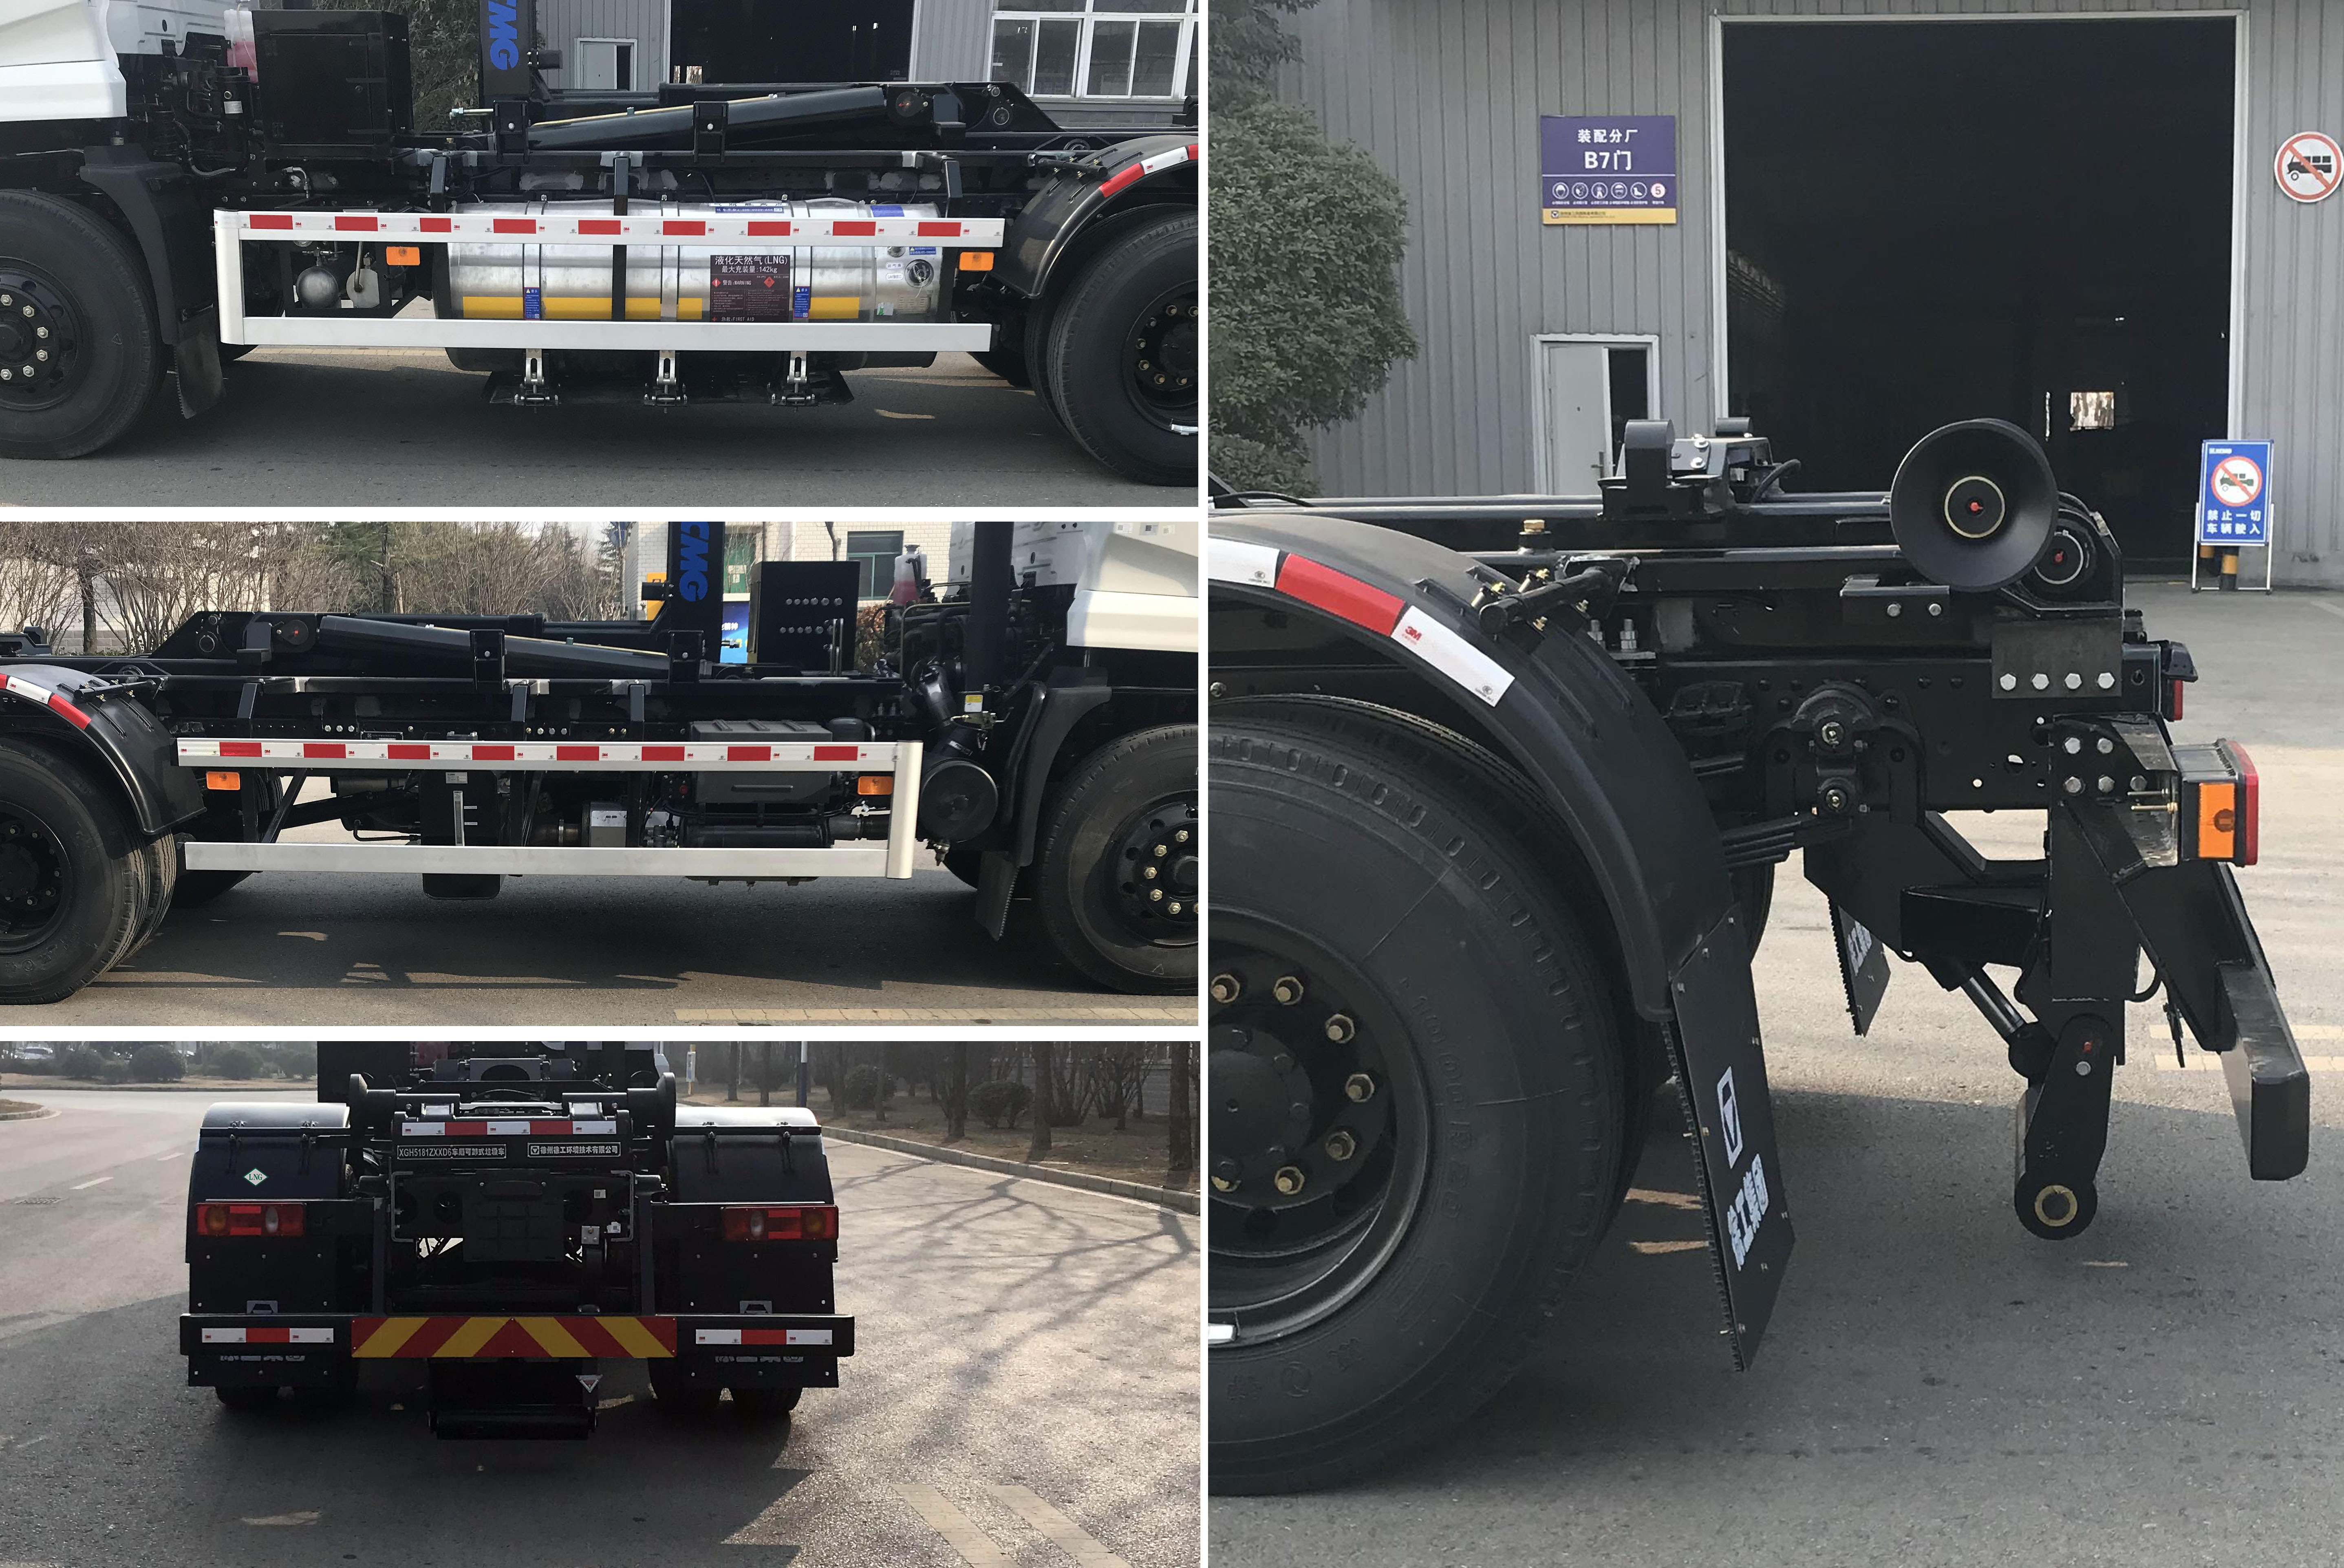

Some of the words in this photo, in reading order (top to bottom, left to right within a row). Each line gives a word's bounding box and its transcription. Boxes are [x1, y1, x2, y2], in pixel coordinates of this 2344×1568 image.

[488, 0, 519, 70] MG
[1577, 128, 1638, 143] 装配分厂
[1584, 150, 1632, 170] B7门
[715, 255, 787, 265] 液化天然气(LNG)
[2207, 509, 2262, 522] 禁止一切
[2206, 523, 2261, 535] 车辆驶入
[721, 622, 739, 631] 精神
[1405, 627, 1421, 641] 3M
[1727, 1153, 1769, 1272] 徐工集团
